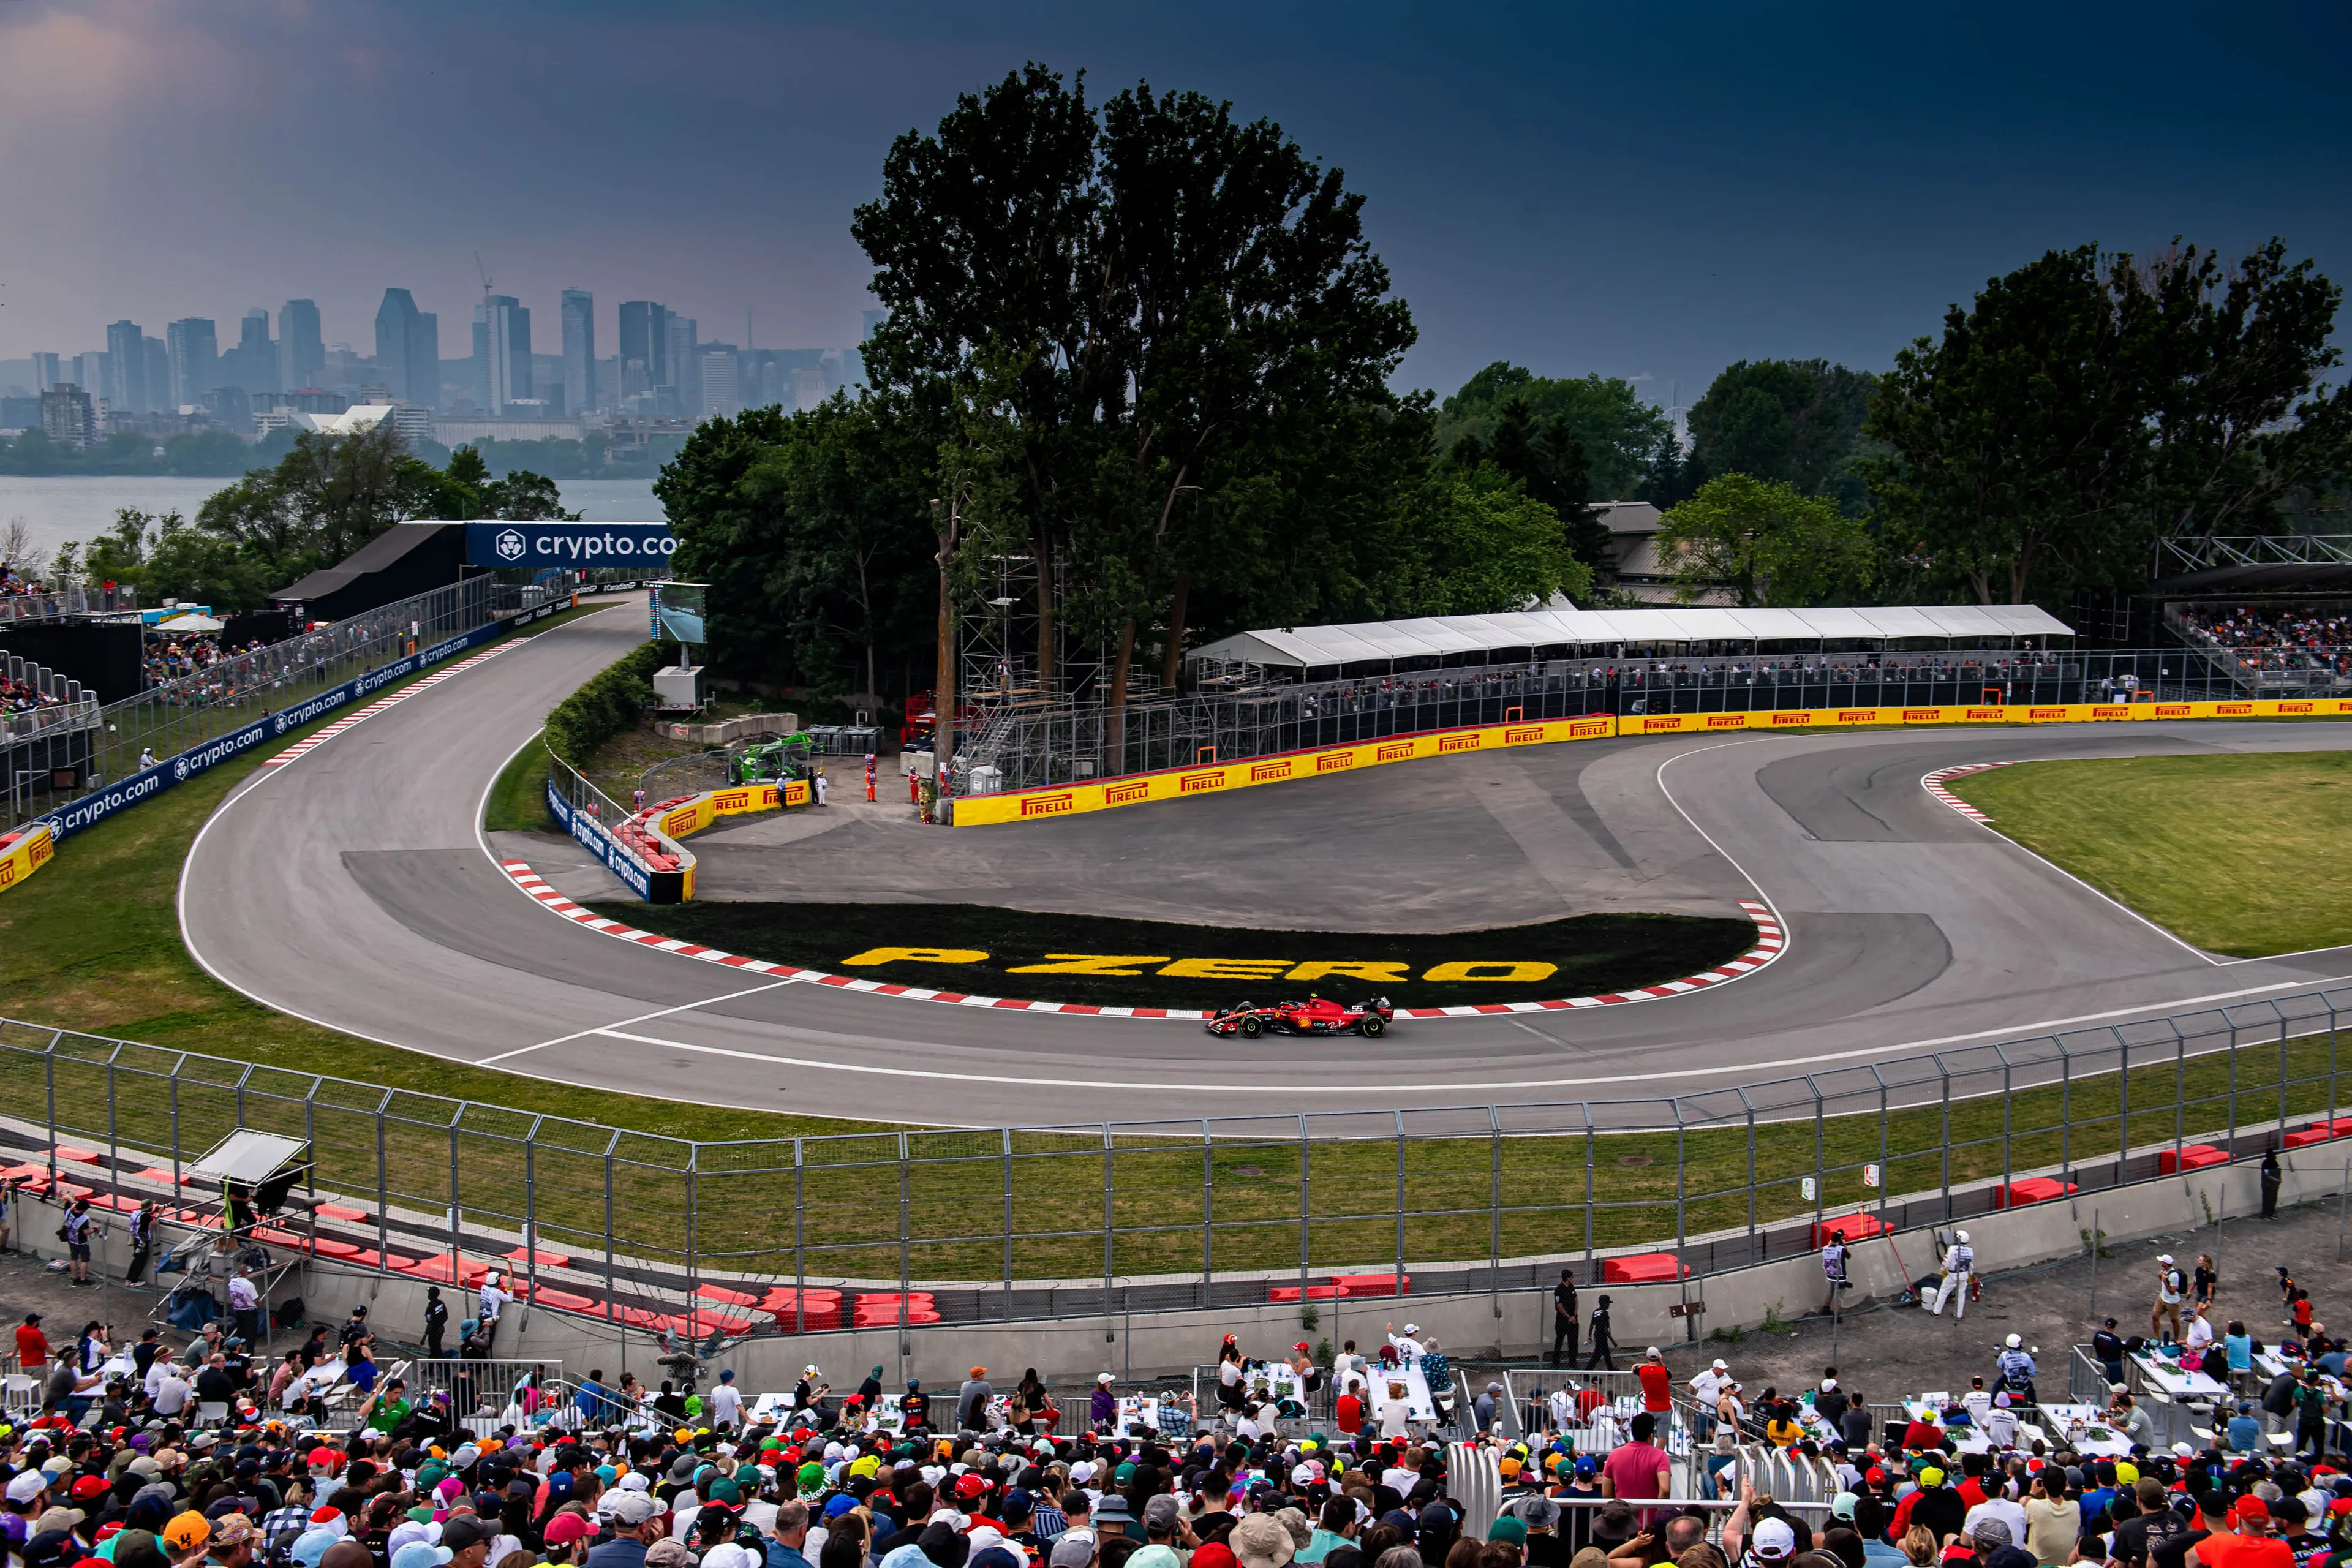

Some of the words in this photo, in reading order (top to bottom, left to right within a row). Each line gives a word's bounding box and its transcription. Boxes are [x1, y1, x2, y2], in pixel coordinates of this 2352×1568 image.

[536, 533, 681, 559] crypto.co
[603, 582, 636, 592] #CanadianGP
[428, 637, 468, 662] crypto.com
[364, 661, 412, 690] crypto.com
[287, 691, 345, 725] crypto.com
[1839, 711, 1876, 722] PIRELLI
[1902, 710, 1940, 720] PIRELLI
[1967, 709, 2003, 719] PIRELLI
[2029, 709, 2066, 719] PIRELLI
[2093, 707, 2128, 717] PIRELLI
[2155, 706, 2190, 715] PIRELLI
[2217, 704, 2252, 714] PIRELLI
[2278, 703, 2313, 712] PIRELLI
[1644, 718, 1681, 729] PIRELLI
[1708, 716, 1744, 726] PIRELLI
[1773, 714, 1810, 725] PIRELLI
[1505, 727, 1544, 743] PIRELLI
[1570, 721, 1607, 737] PIRELLI
[190, 728, 263, 769] crypto.com
[1378, 742, 1414, 761] PIRELLI
[1439, 734, 1480, 752] PIRELLI
[1317, 752, 1353, 771] PIRELLI
[1251, 761, 1291, 781] PIRELLI
[1181, 771, 1224, 792] PIRELLI
[65, 775, 159, 828] crypto.com
[1106, 782, 1148, 804] PIRELLI
[1021, 793, 1072, 815] PIRELLI
[669, 809, 697, 837] PIRELLI
[576, 822, 604, 857] crypto.com
[615, 856, 647, 895] crypto.com
[840, 946, 990, 966] P
[1006, 954, 1558, 982] ZERO
[417, 1412, 440, 1423] ETRONAS
[2291, 1543, 2332, 1559] ETRONAS
